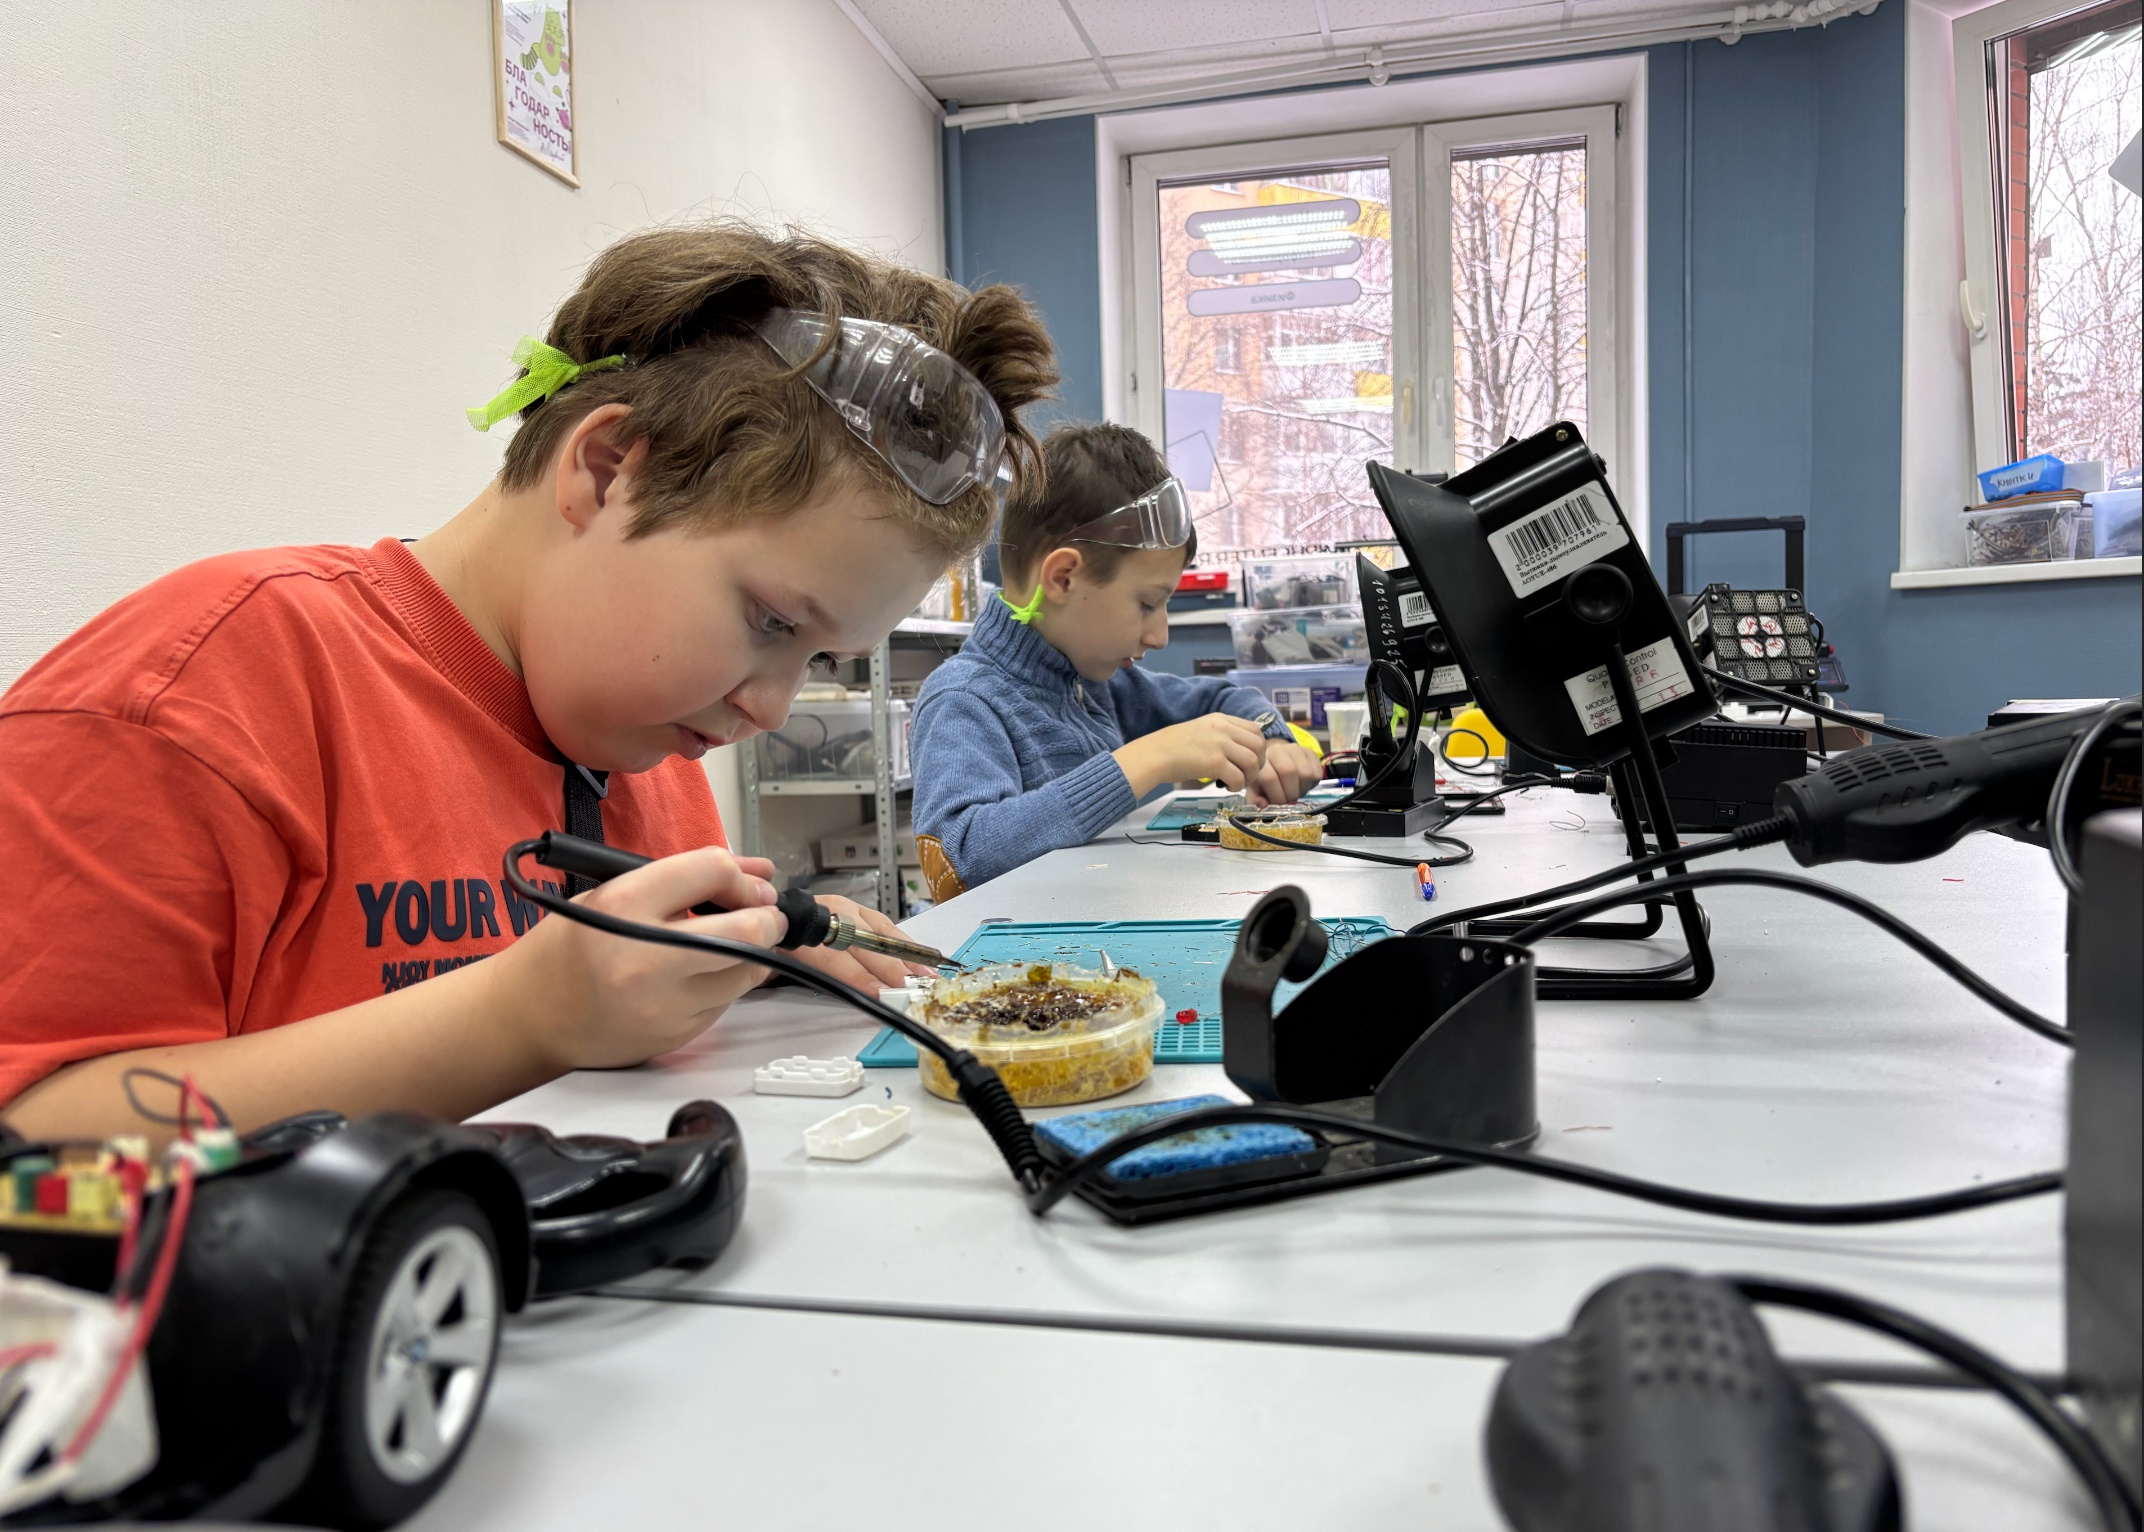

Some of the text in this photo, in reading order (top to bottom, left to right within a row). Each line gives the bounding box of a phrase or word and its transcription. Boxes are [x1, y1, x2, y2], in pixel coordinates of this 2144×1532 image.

[505, 58, 528, 87] БЛА
[514, 85, 550, 120] ГОДАР
[355, 878, 501, 948] YOUR
